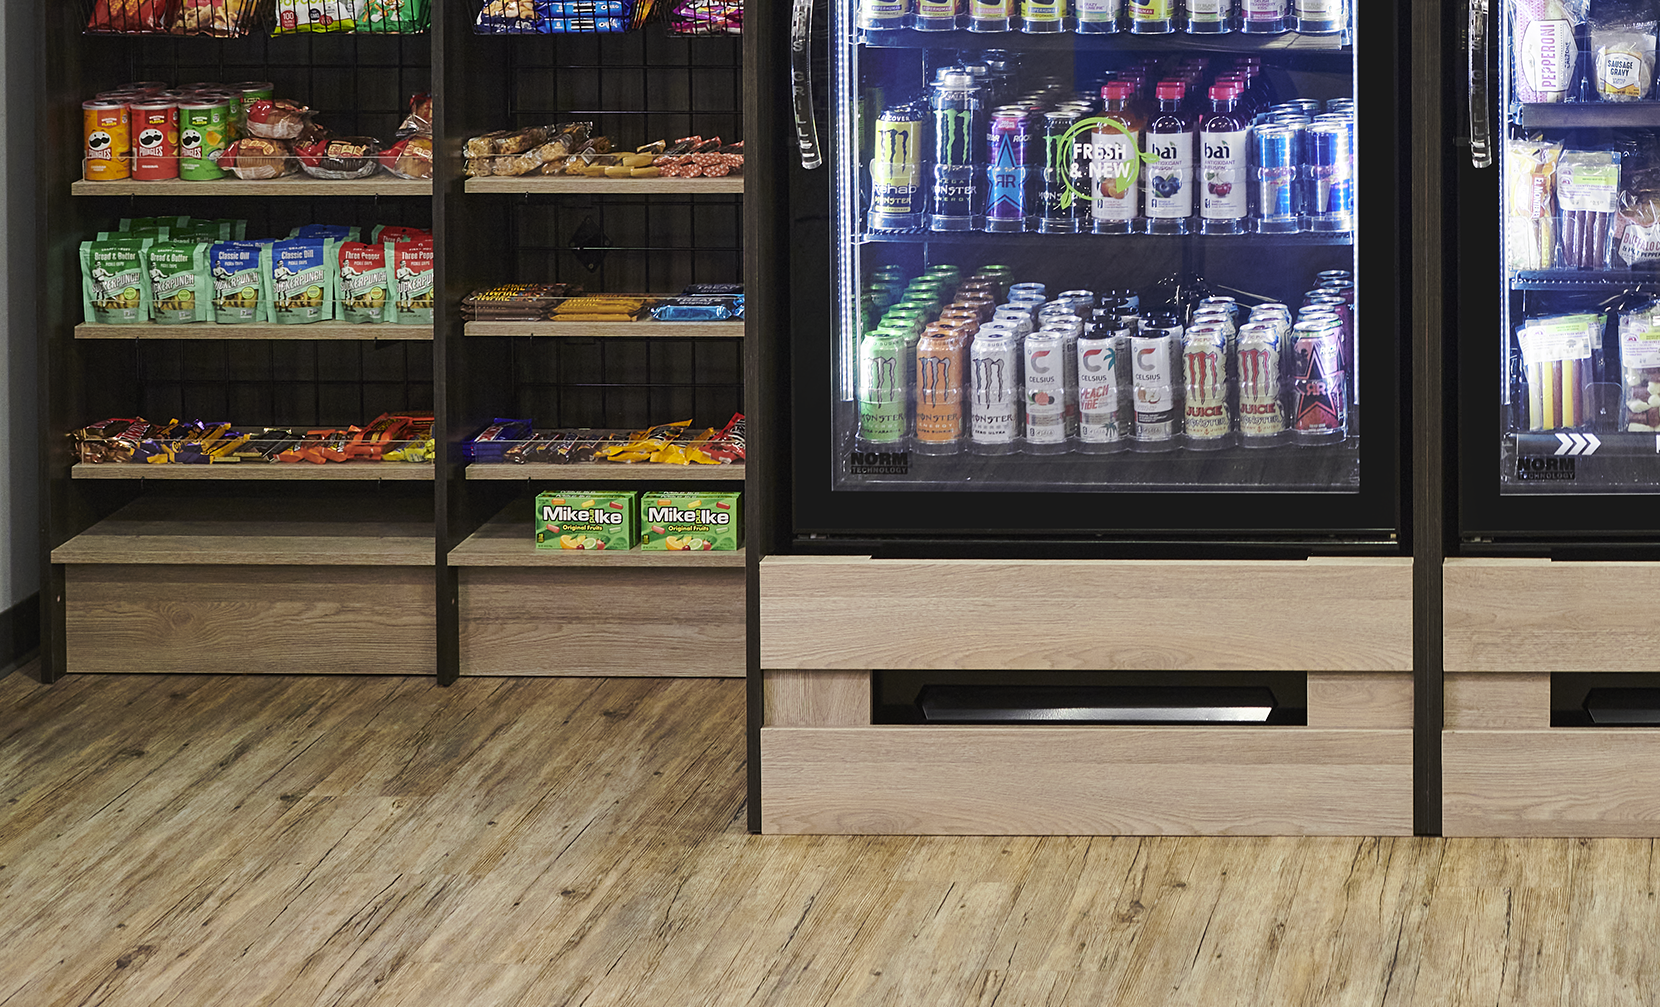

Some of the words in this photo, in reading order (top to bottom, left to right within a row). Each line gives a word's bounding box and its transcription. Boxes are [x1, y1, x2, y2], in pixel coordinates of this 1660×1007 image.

[1540, 24, 1557, 88] PEPPERONI
[1607, 59, 1633, 70] SAUSAGE
[1610, 67, 1630, 77] GRAVY
[138, 146, 164, 158] PRINGLES
[1073, 143, 1127, 160] FRESH
[1204, 141, 1231, 158] bai
[1069, 163, 1082, 178] &
[1089, 162, 1131, 178] NEW
[281, 251, 303, 259] Classic
[1187, 405, 1223, 417] JUICE
[1240, 403, 1276, 415] JUICE
[850, 452, 908, 465] NORM
[1518, 457, 1575, 470] NORM
[851, 466, 908, 474] TECHNOLOGY
[543, 506, 590, 522] Mike
[594, 509, 623, 524] Ike
[648, 507, 696, 523] Mike
[701, 510, 730, 524] Ike
